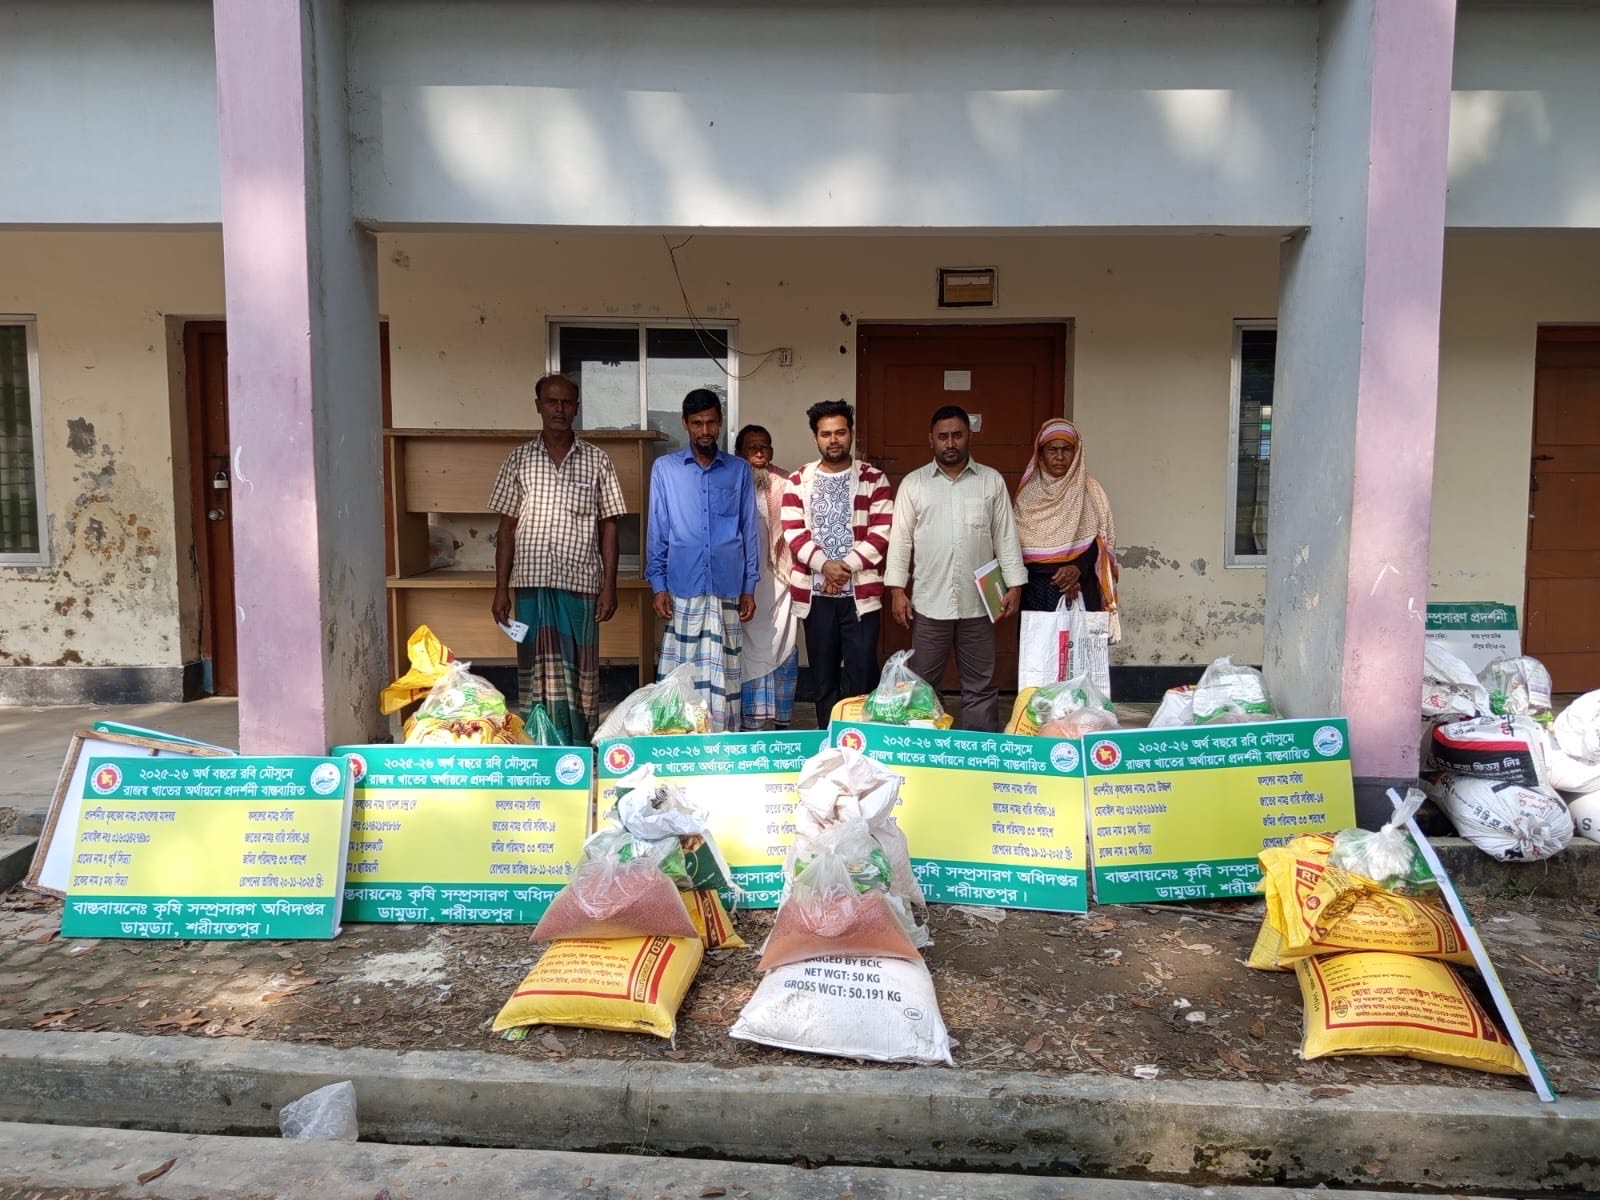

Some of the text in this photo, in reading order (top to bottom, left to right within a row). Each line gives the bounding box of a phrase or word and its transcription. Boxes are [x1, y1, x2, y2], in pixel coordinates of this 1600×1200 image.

[1470, 608, 1508, 624] প্রদর্শনী
[652, 740, 802, 758] ২০২৫-২৬ অর্থ বছরে রবি মৌসুমে
[883, 735, 1033, 757] ২০২৫-২৬ অর্থ বছরে রবি মৌসুমে
[1138, 732, 1295, 755] ২০২৫-২৬ অর্থ বছরে রবি মৌসুমে
[384, 754, 539, 771] ২০২৫-২৬ অর্থ বছরে রবি মৌসুমে
[665, 762, 696, 773] খাতের
[737, 756, 770, 770] প্রদর্শনী
[896, 751, 926, 764] খাতের
[929, 752, 965, 767] অর্থায়নে
[967, 754, 1000, 770] প্রদর্শনী
[1003, 757, 1047, 773] বাস্তবায়িত
[1125, 747, 1310, 771] রাজস্ব খাতের অর্থায়নে প্রদর্শনী বাস্তবায়িত
[139, 765, 294, 781] ২০২৫-২৬ অর্থ বছরে রবি মৌসুমে
[369, 771, 551, 787] রাজস্ব খাতের অর্থায়নে প্রদর্শনী বাস্তবায়িত
[1289, 770, 1304, 784] সরিষা
[123, 781, 306, 797] রাজস্ব খাতের অর্থায়নে প্রদর্শনী বাস্তবায়িত
[1023, 781, 1038, 795] সরিষা
[526, 797, 541, 810] সরিষা
[279, 807, 295, 821] সরিষা
[1298, 816, 1307, 825] ৩৩
[1308, 813, 1326, 824] শতাংশ
[912, 862, 1078, 888] কৃষি সম্প্রসারণ অধিদপ্তর
[1104, 869, 1179, 884] বাস্তবায়নেঃ
[1182, 864, 1213, 884] কৃষি
[344, 889, 403, 902] স্তবায়নেঃ
[408, 886, 437, 906] কৃষি
[441, 888, 509, 903] সম্প্রসারণ
[946, 882, 1019, 904] শরীয়তপুর
[73, 900, 326, 920] বাস্তবায়নেঃ কৃষি সম্প্রসারণ অধিদপ্তর
[440, 906, 514, 923] শরীয়তপুর
[186, 921, 262, 939] শরীয়তপুর
[845, 958, 858, 966] BY
[804, 968, 880, 983] NET WGT: 50 KG
[784, 979, 902, 1002] GROSS WGT: 50.191 KG
